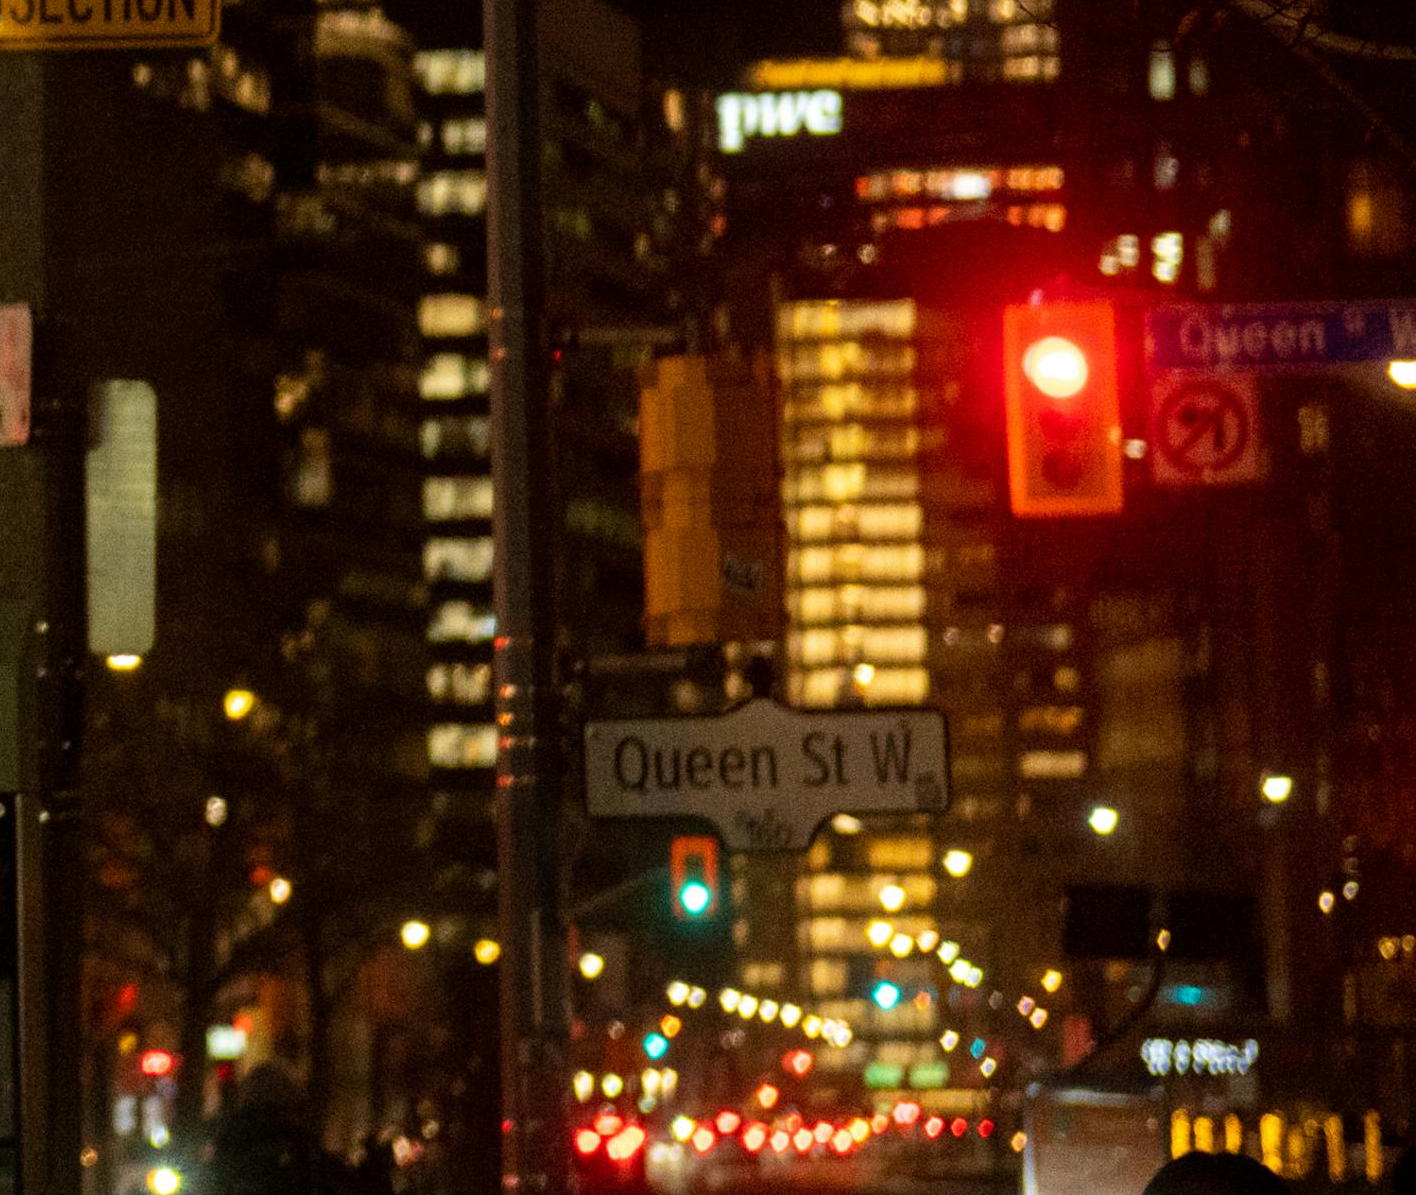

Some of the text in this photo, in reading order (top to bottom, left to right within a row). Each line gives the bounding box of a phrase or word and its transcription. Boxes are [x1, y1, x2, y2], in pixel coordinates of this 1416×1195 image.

[1178, 308, 1327, 359] Queen
[613, 728, 913, 795] Queen St W
